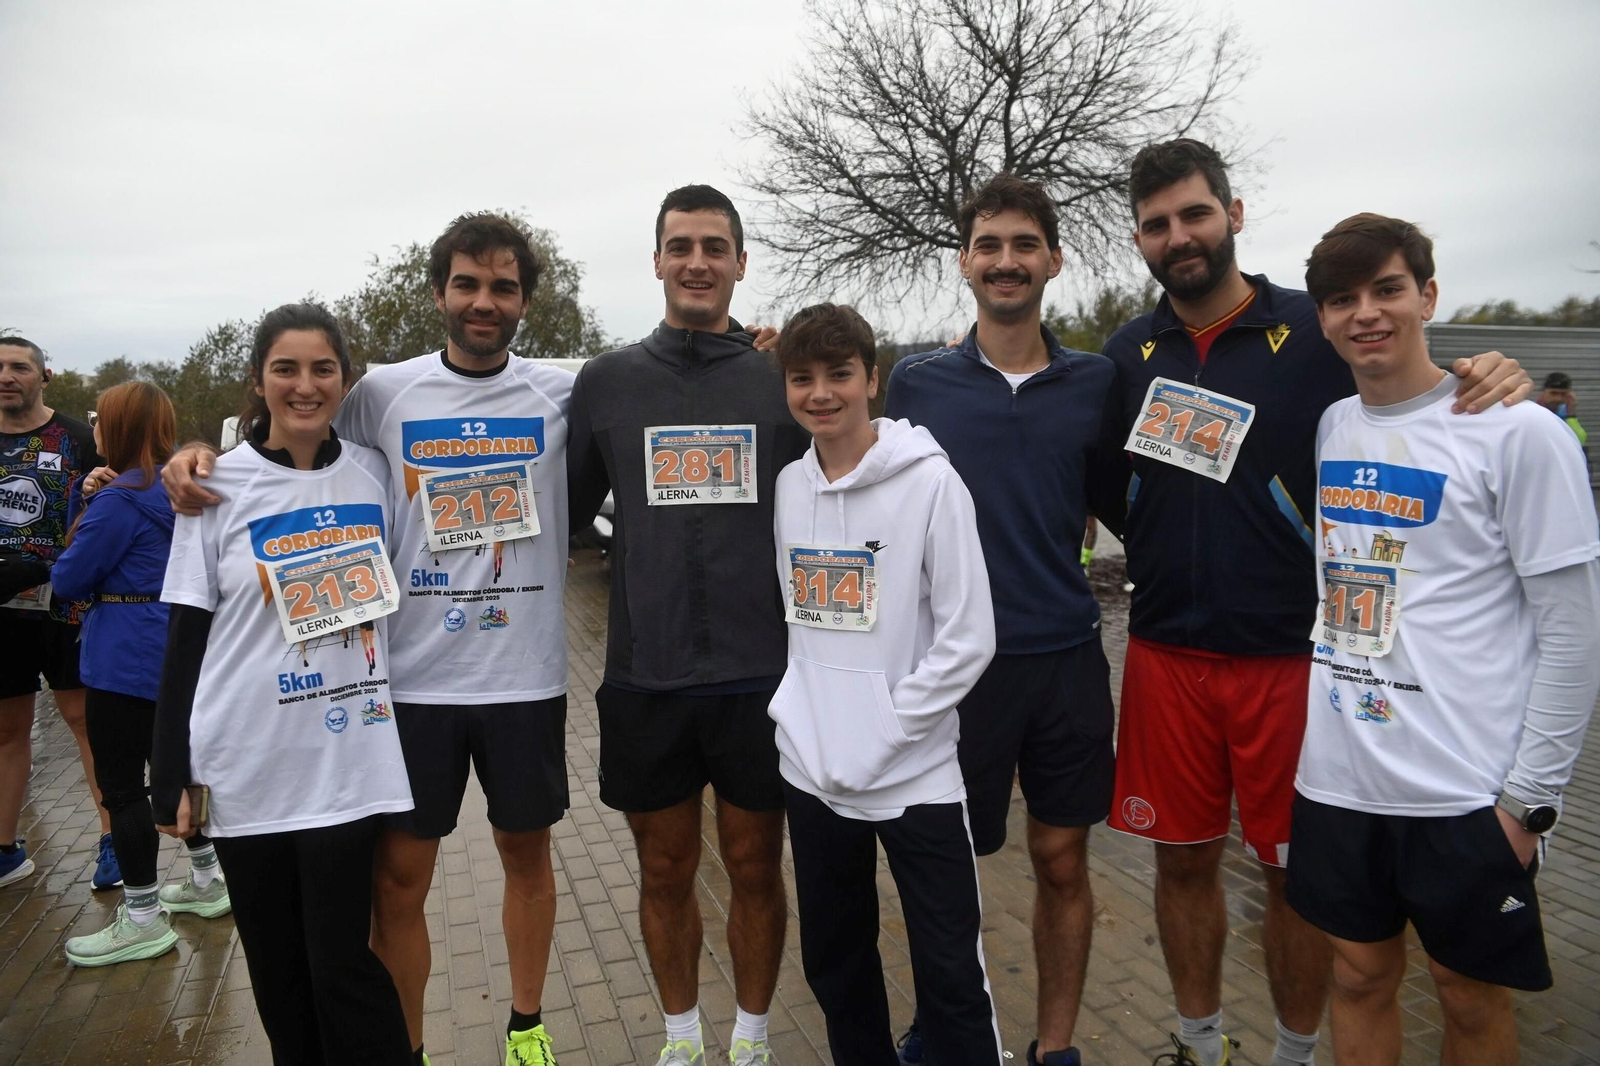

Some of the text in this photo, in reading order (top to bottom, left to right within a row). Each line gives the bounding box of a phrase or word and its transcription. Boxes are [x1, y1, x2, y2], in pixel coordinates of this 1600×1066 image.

[1161, 390, 1241, 419] CORDOBARIA
[1192, 393, 1210, 401] 12
[461, 422, 487, 436] 12
[1139, 402, 1226, 455] 214
[410, 437, 538, 459] CORDOBARIA
[40, 461, 57, 469] AXA
[652, 448, 734, 485] 281
[434, 472, 521, 488] CORDOBARIA
[1352, 468, 1378, 486] 12
[430, 486, 520, 530] 212
[313, 510, 337, 526] 12
[0, 536, 54, 546] DRID 2025
[865, 540, 880, 551] NIKE
[411, 569, 448, 587] 5km
[283, 566, 378, 621] 213
[793, 568, 862, 608] 314
[125, 594, 150, 603] KEEPER
[1324, 584, 1376, 630] 211
[1313, 657, 1328, 665] ANCO
[1332, 664, 1360, 674] ENTOS
[278, 672, 324, 694] 5km
[1333, 673, 1363, 683] ICEMBRE
[278, 695, 305, 705] BANCO
[319, 683, 358, 697] ALIMENTOS
[330, 690, 362, 702] DICIEMBRE
